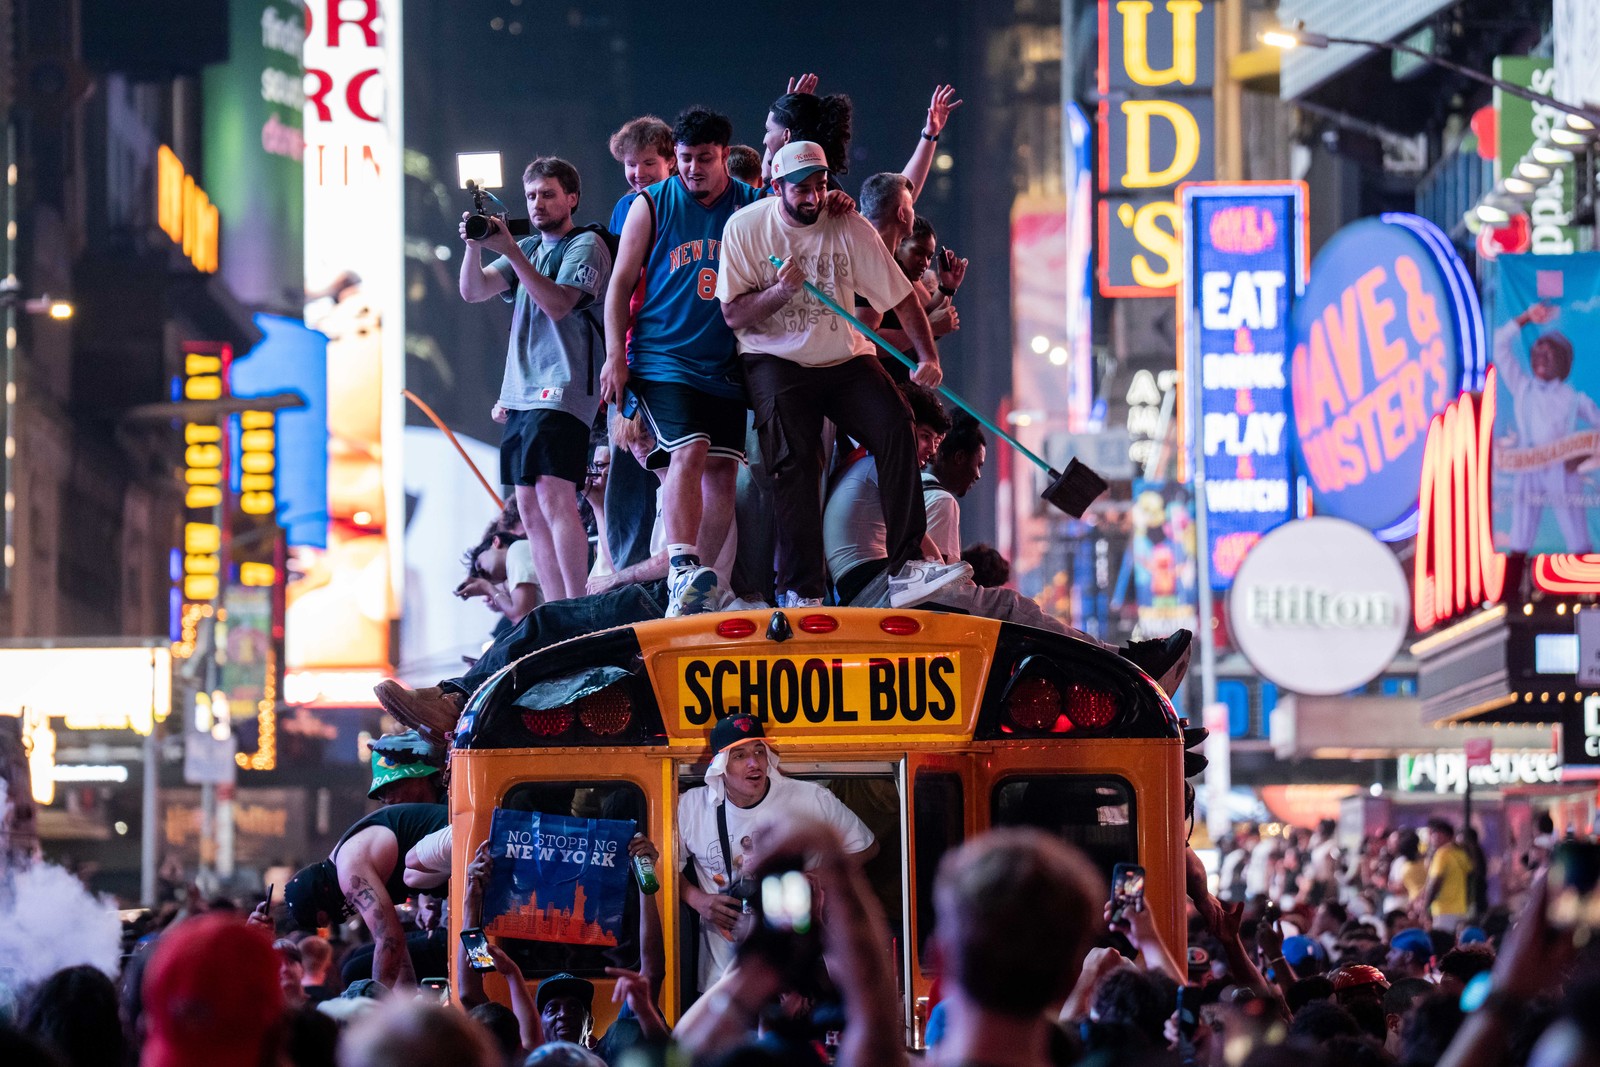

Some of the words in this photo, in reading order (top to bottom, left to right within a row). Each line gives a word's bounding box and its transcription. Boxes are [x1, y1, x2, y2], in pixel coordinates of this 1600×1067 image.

[669, 239, 703, 274] NEW
[696, 267, 718, 300] 8
[1202, 270, 1287, 330] EAT
[1203, 411, 1288, 457] PLAY
[1245, 582, 1394, 630] Hilton
[684, 657, 859, 726] SCHOOL
[868, 655, 957, 722] BUS
[505, 843, 555, 863] NEW
[559, 848, 615, 868] YORK
[507, 829, 531, 844] NO
[537, 834, 618, 853] STOPPNG
